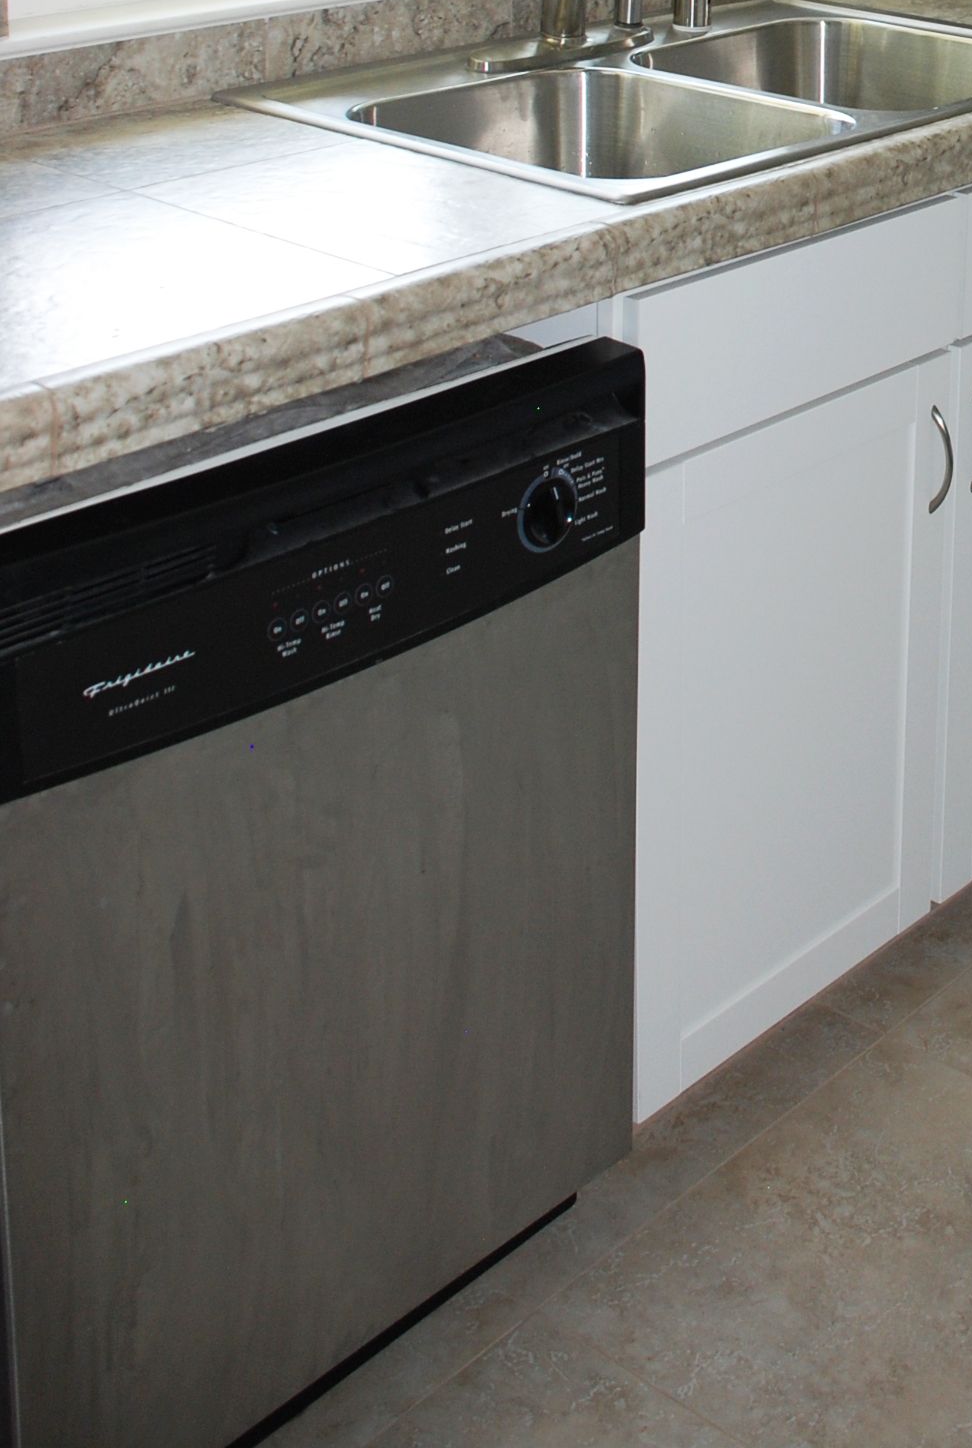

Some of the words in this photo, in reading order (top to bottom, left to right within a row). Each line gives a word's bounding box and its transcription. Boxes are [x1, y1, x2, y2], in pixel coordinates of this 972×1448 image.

[501, 507, 518, 519] Drying
[444, 525, 459, 535] Delay
[459, 518, 473, 529] Start
[445, 541, 467, 555] Washing
[311, 559, 351, 579] OPTIONS
[445, 564, 461, 575] Clean
[82, 649, 196, 699] Frigidaire
